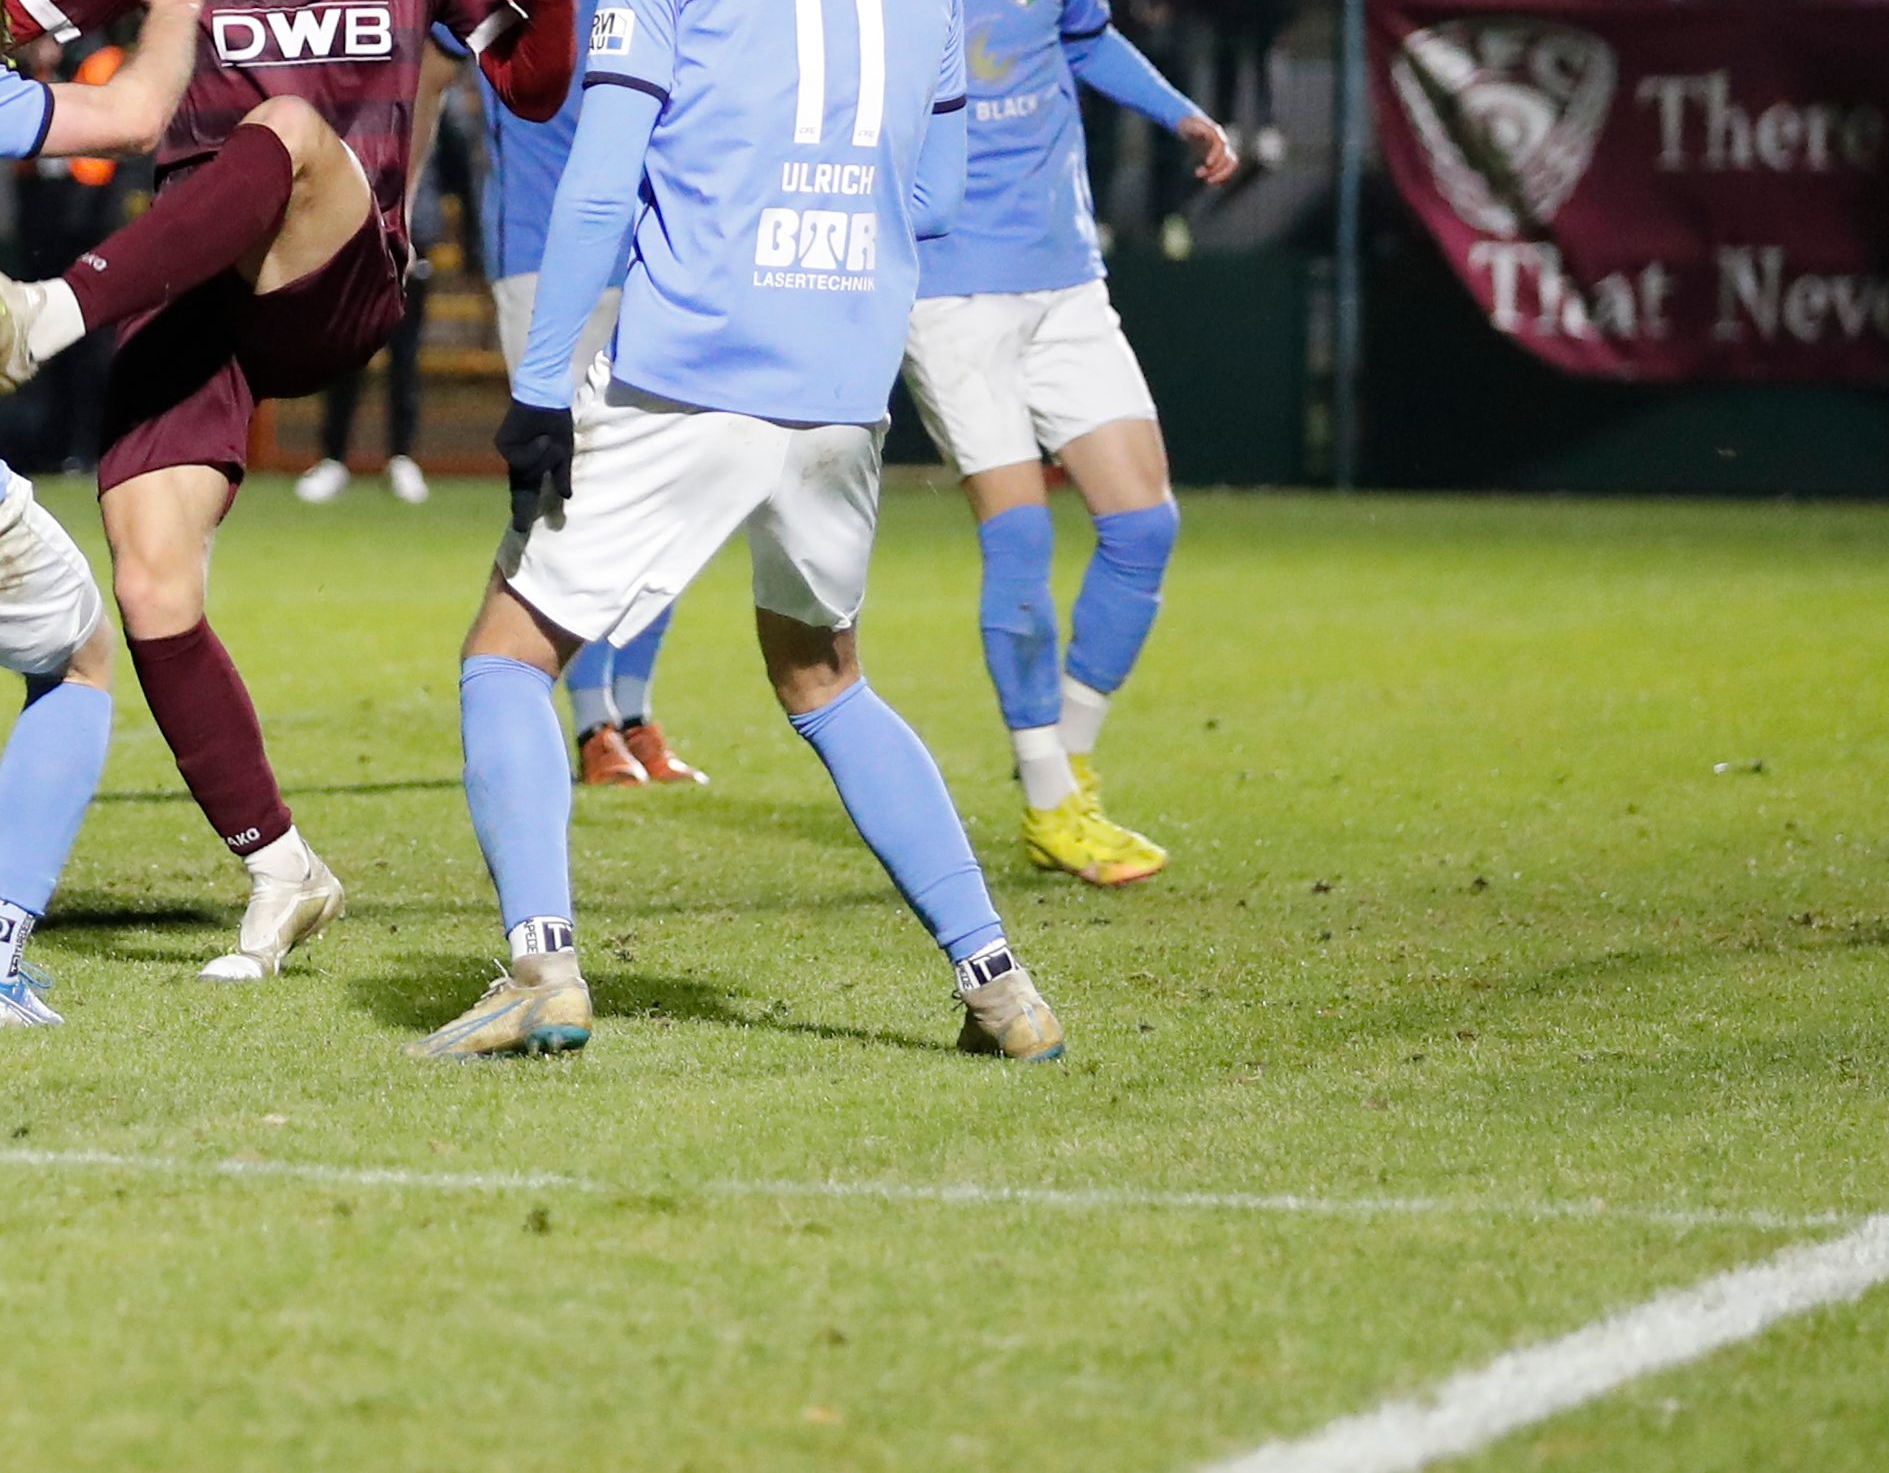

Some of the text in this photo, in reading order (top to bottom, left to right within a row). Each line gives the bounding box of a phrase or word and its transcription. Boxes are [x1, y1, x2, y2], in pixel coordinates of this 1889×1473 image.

[213, 8, 393, 61] DWB
[782, 162, 876, 195] ULRICH
[752, 271, 876, 292] LASERTECHNIK
[1468, 240, 1674, 340] That
[227, 827, 261, 847] AKO
